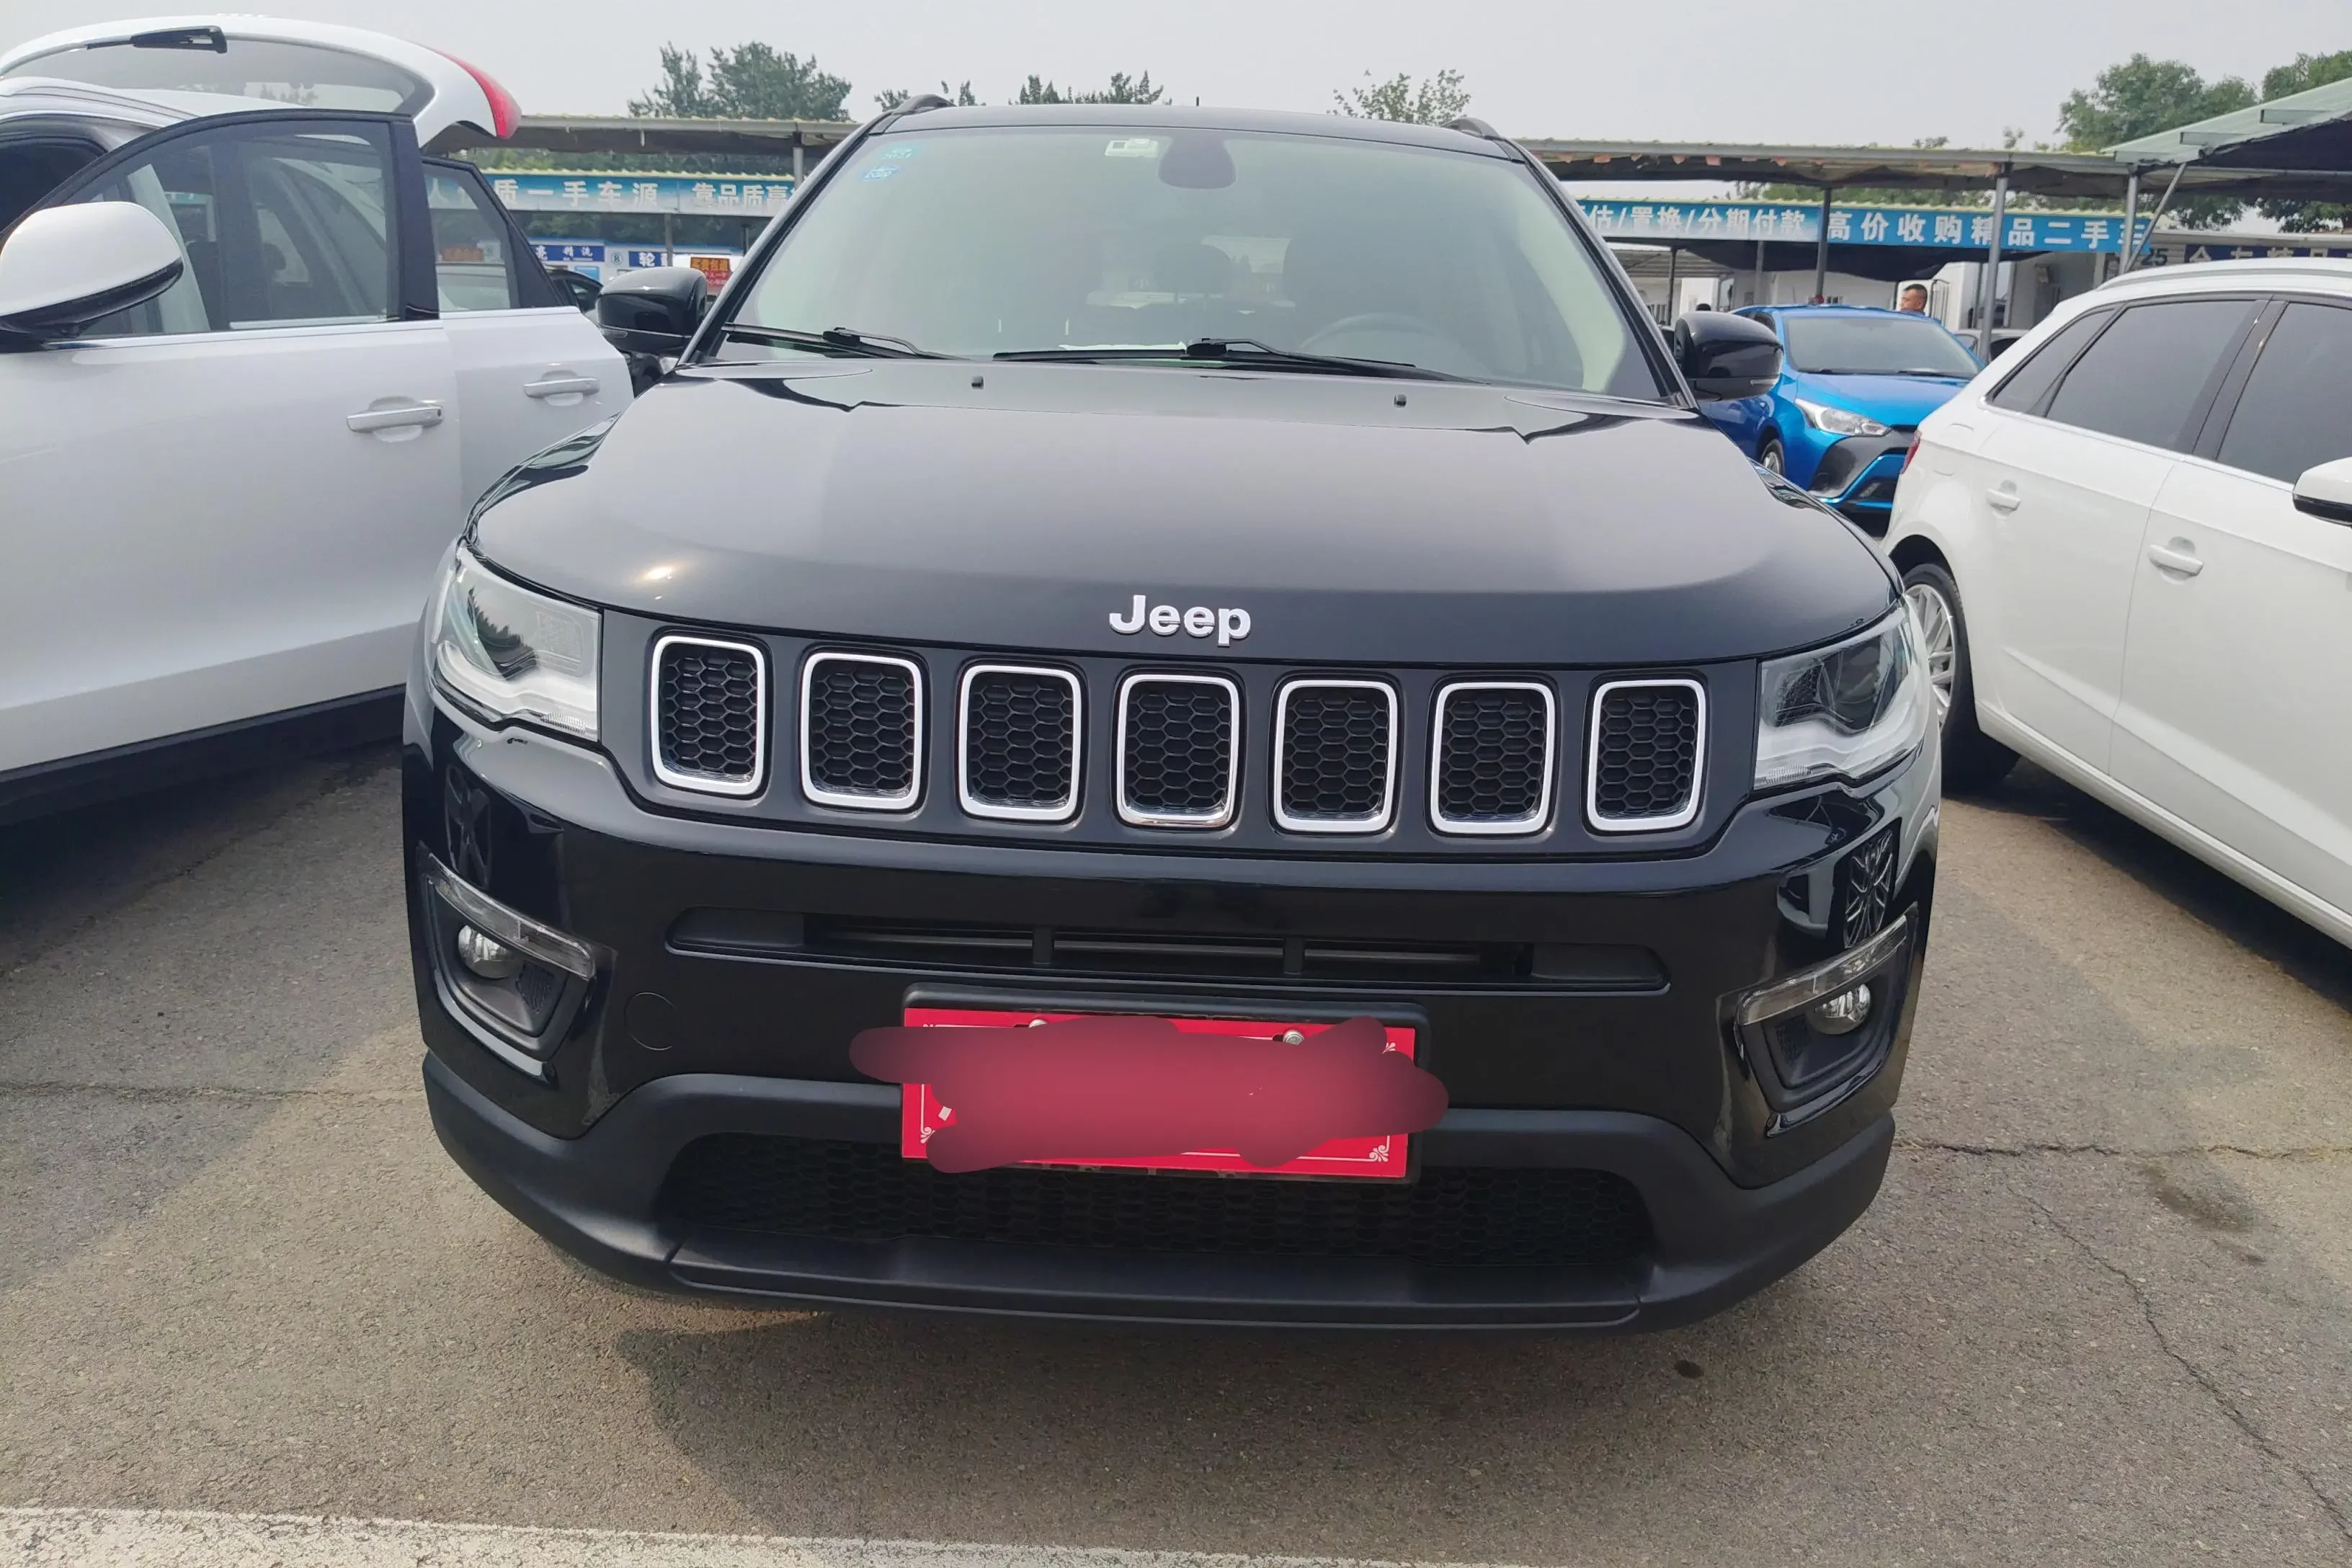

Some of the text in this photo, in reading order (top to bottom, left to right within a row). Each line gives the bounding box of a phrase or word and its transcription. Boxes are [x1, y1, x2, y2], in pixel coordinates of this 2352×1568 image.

[1580, 205, 1806, 236] 估/置换/分期付款
[1109, 594, 1251, 647] Jeep
